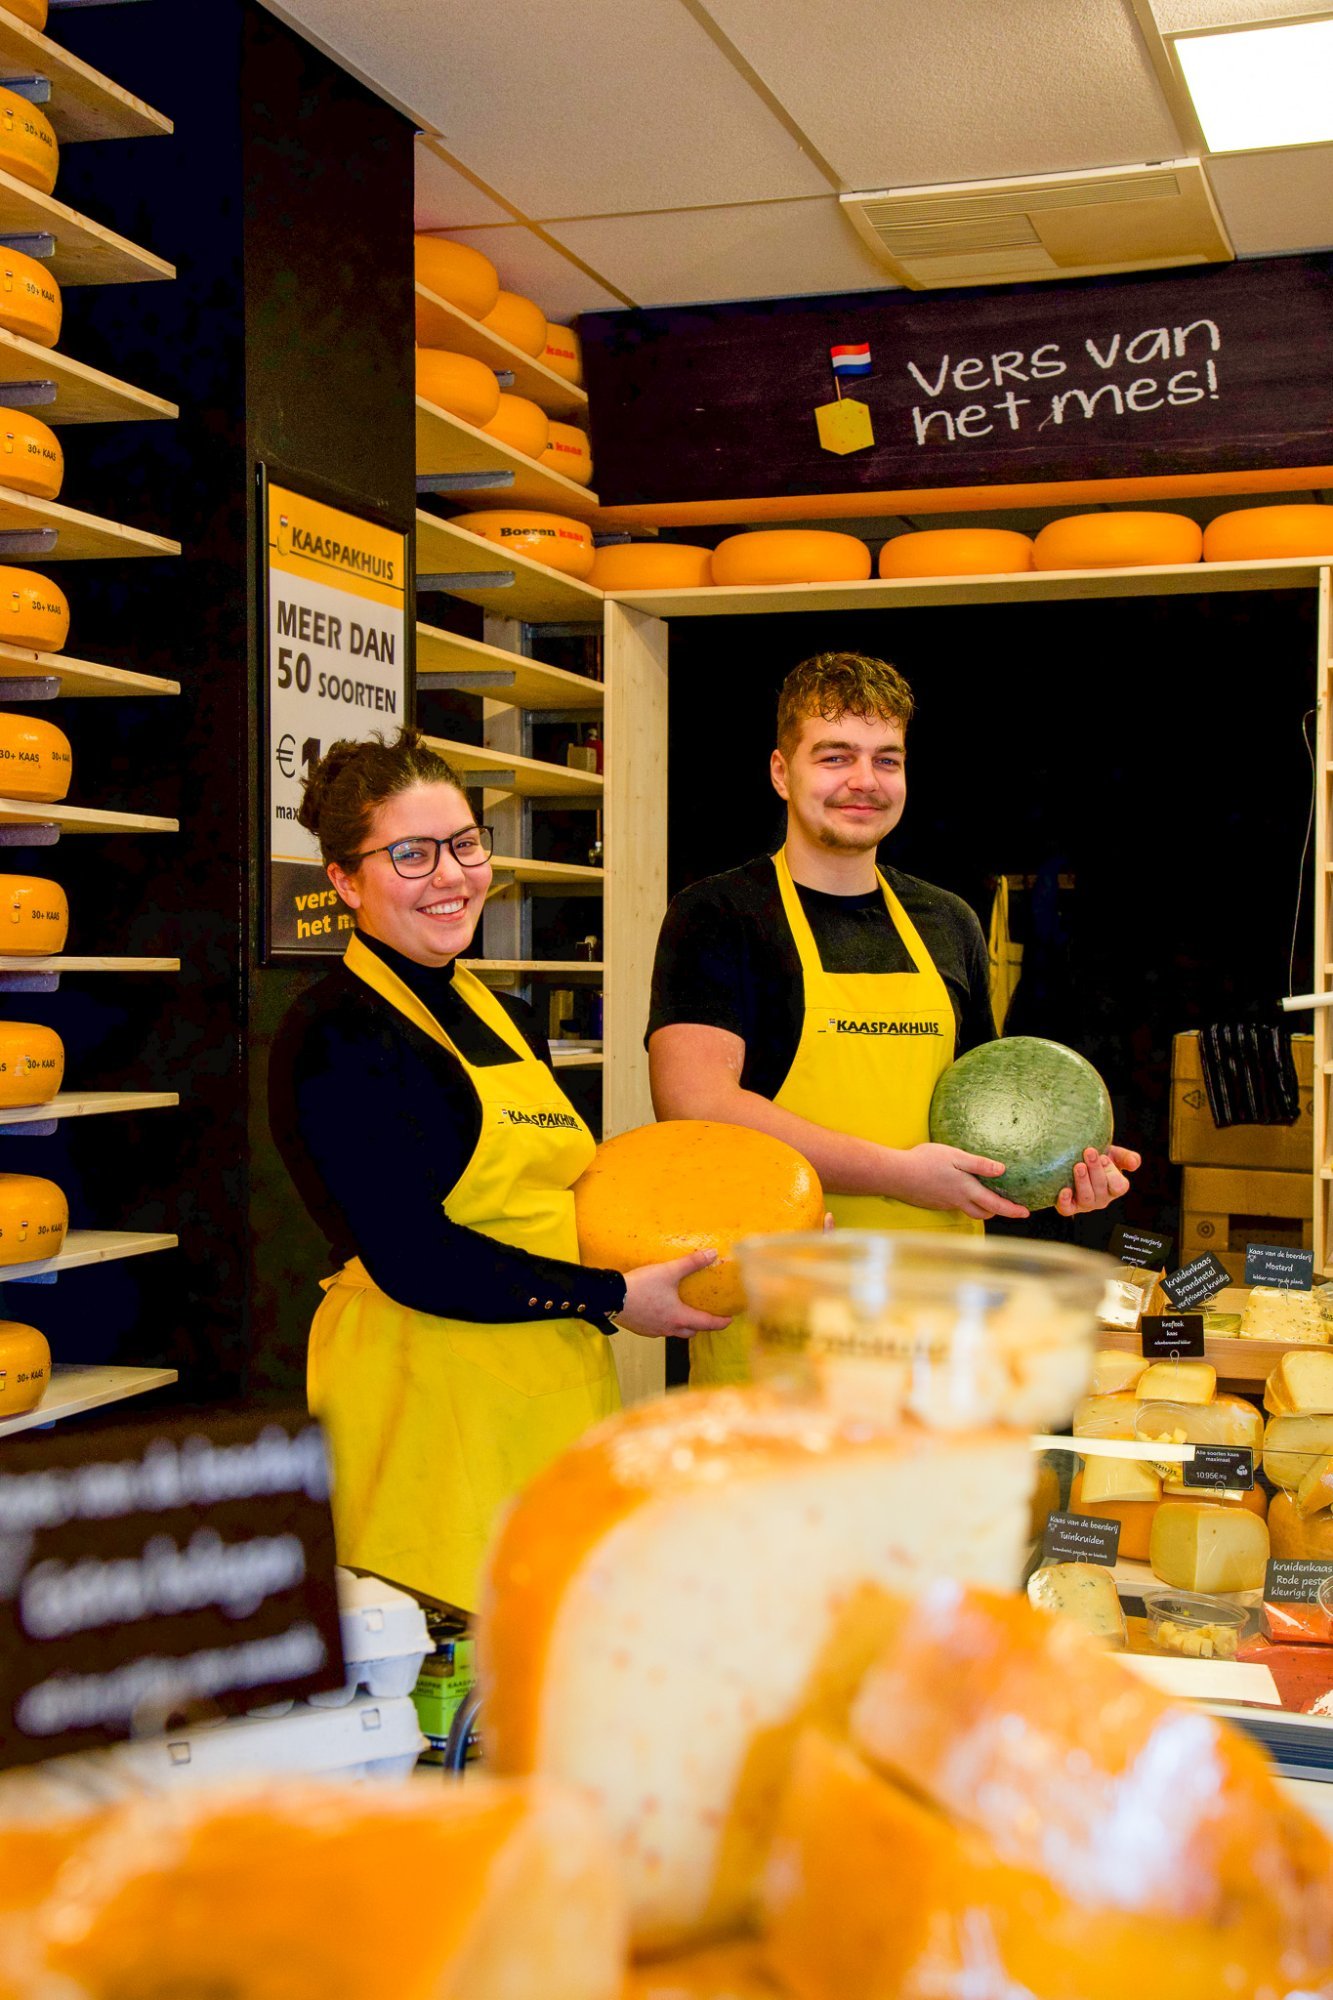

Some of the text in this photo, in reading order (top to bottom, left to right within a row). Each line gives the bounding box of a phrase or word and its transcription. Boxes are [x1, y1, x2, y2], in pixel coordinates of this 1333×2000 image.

[912, 359, 1220, 445] het mes!
[27, 443, 57, 462] 30+ KAAS
[500, 527, 557, 538] Boeren
[292, 526, 394, 581] KAASPAKHUIS
[31, 600, 62, 615] 30+ KAAS
[277, 599, 396, 666] MEER DAN
[277, 646, 397, 715] 50 SOORTEN
[18, 751, 40, 763] KAAS
[295, 889, 338, 911] vers
[31, 910, 60, 921] 30+ KAAS
[297, 915, 332, 940] het
[836, 1019, 939, 1034] KAASPAKHUIS
[26, 1058, 56, 1069] 30+ KAAS
[1248, 1247, 1313, 1263] Kaas van de boerderij
[1164, 1256, 1212, 1289] kruidenkaas
[1264, 1261, 1294, 1273] Mosterd
[1175, 1266, 1217, 1297] Brandnetel
[1207, 1273, 1230, 1291] kruidig
[1049, 1515, 1119, 1535] Kaas van de boerderij
[1059, 1531, 1105, 1546] Tuinkruiden
[1272, 1560, 1333, 1573] kruidenkaas
[1276, 1574, 1300, 1585] Rode
[1270, 1586, 1307, 1600] kleurige
